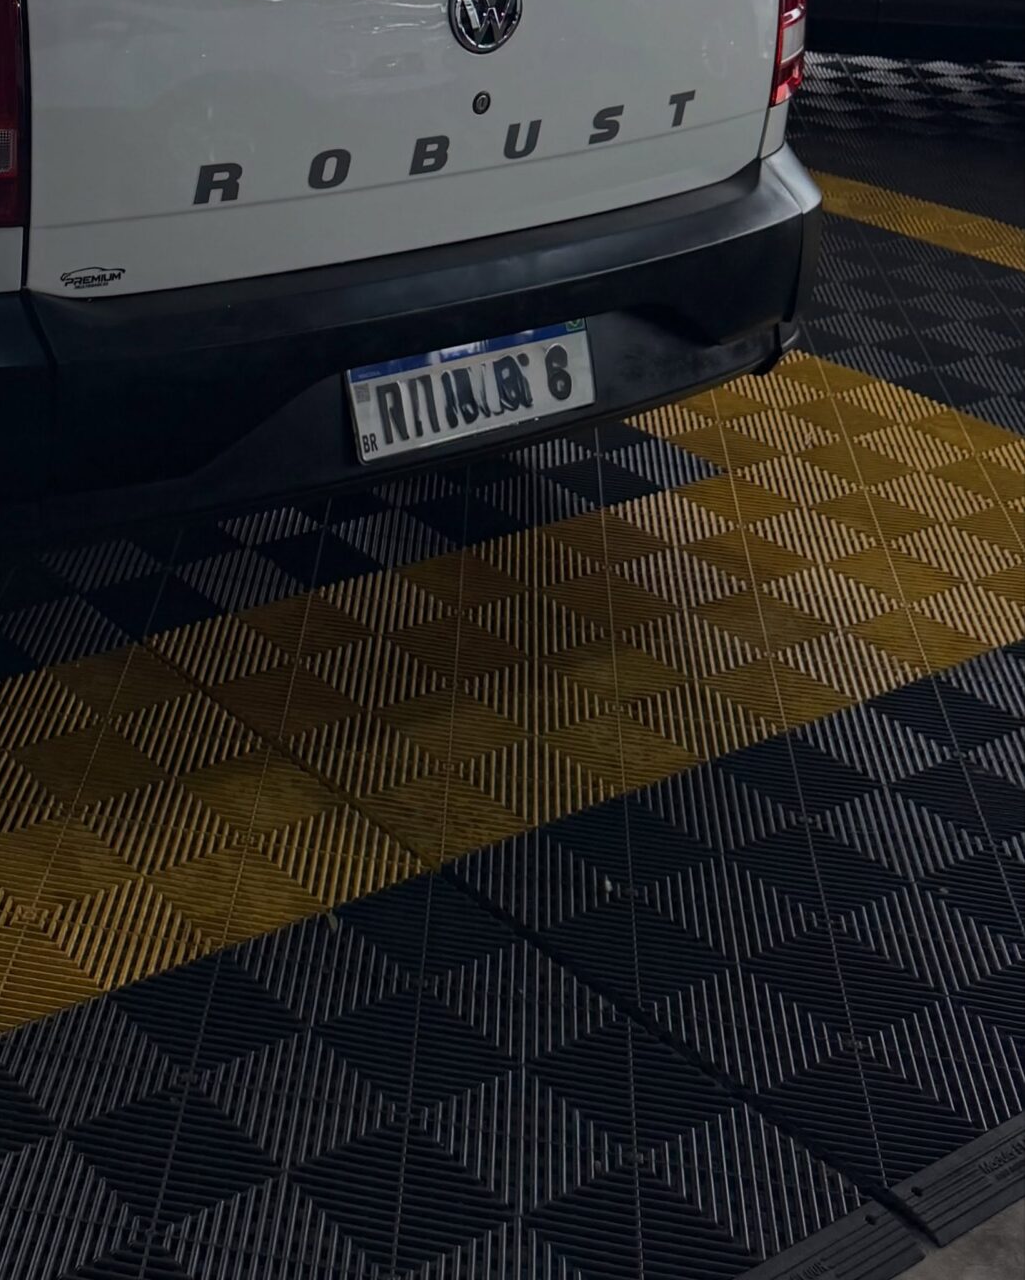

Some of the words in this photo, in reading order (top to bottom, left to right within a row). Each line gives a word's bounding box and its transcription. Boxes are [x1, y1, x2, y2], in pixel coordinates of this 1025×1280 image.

[192, 89, 697, 206] ROBUST
[64, 271, 122, 287] PREMIUM
[361, 432, 379, 454] BR
